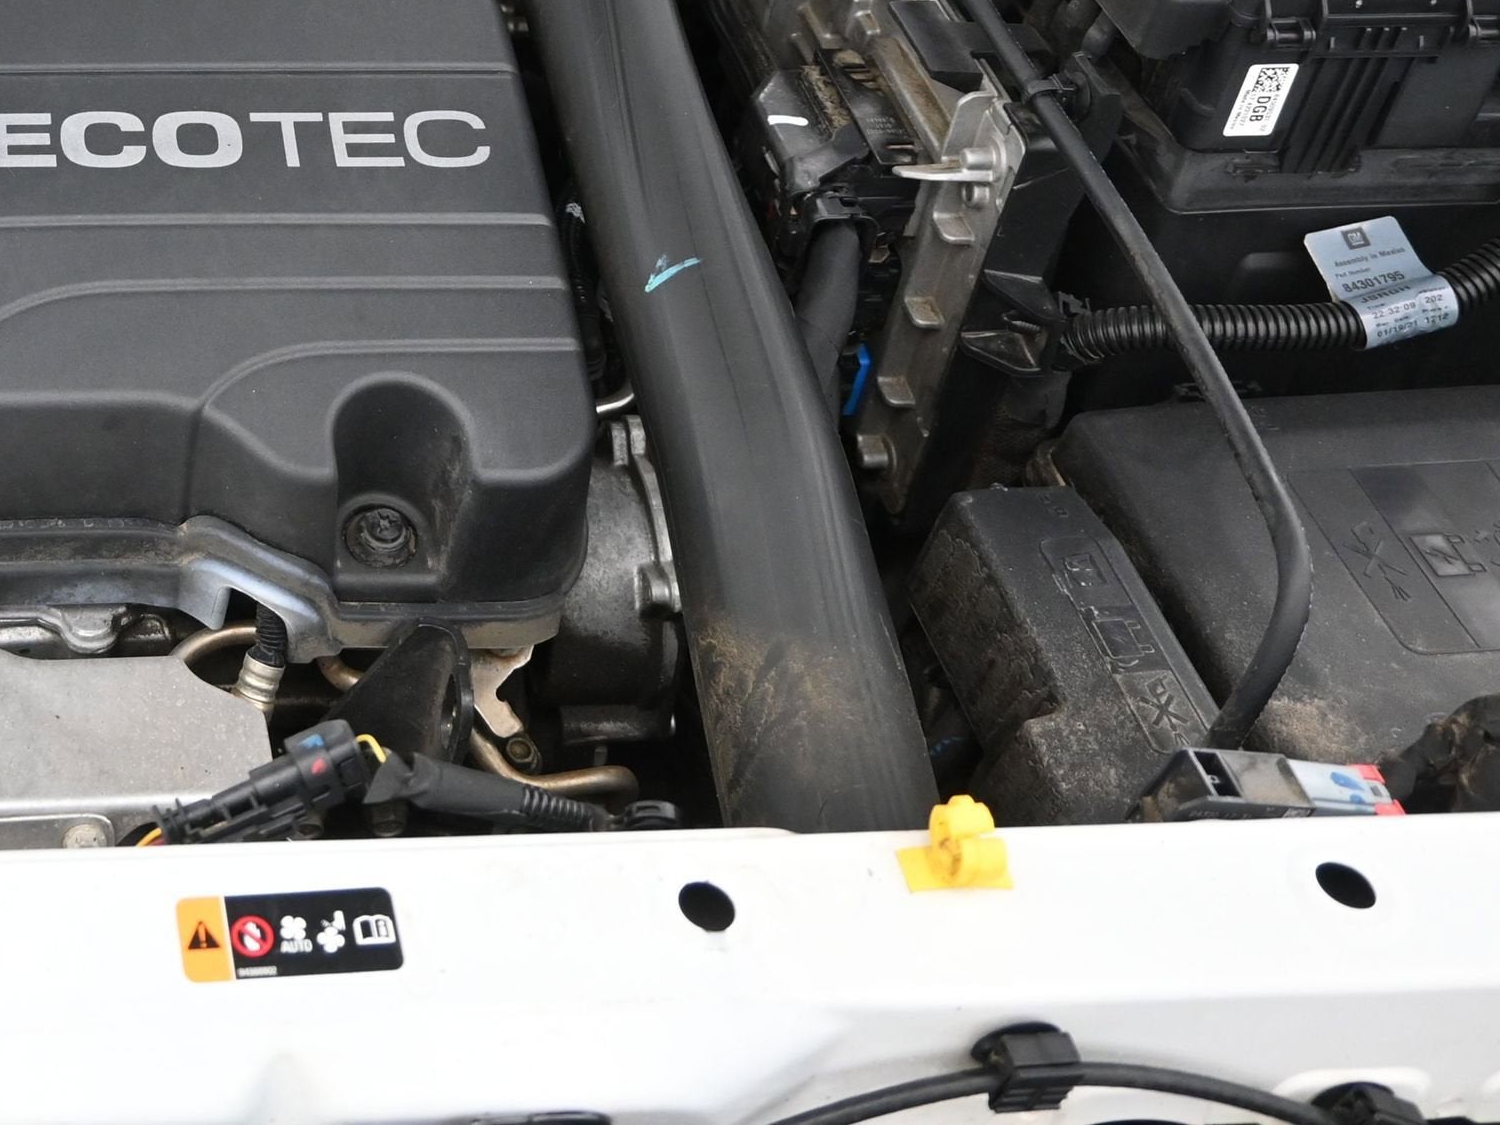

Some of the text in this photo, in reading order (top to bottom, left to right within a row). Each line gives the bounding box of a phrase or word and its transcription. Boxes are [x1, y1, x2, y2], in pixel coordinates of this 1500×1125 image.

[1247, 96, 1272, 122] DGB
[1341, 270, 1406, 293] 84301795
[1423, 293, 1444, 304] 202
[280, 939, 313, 953] AUTO
